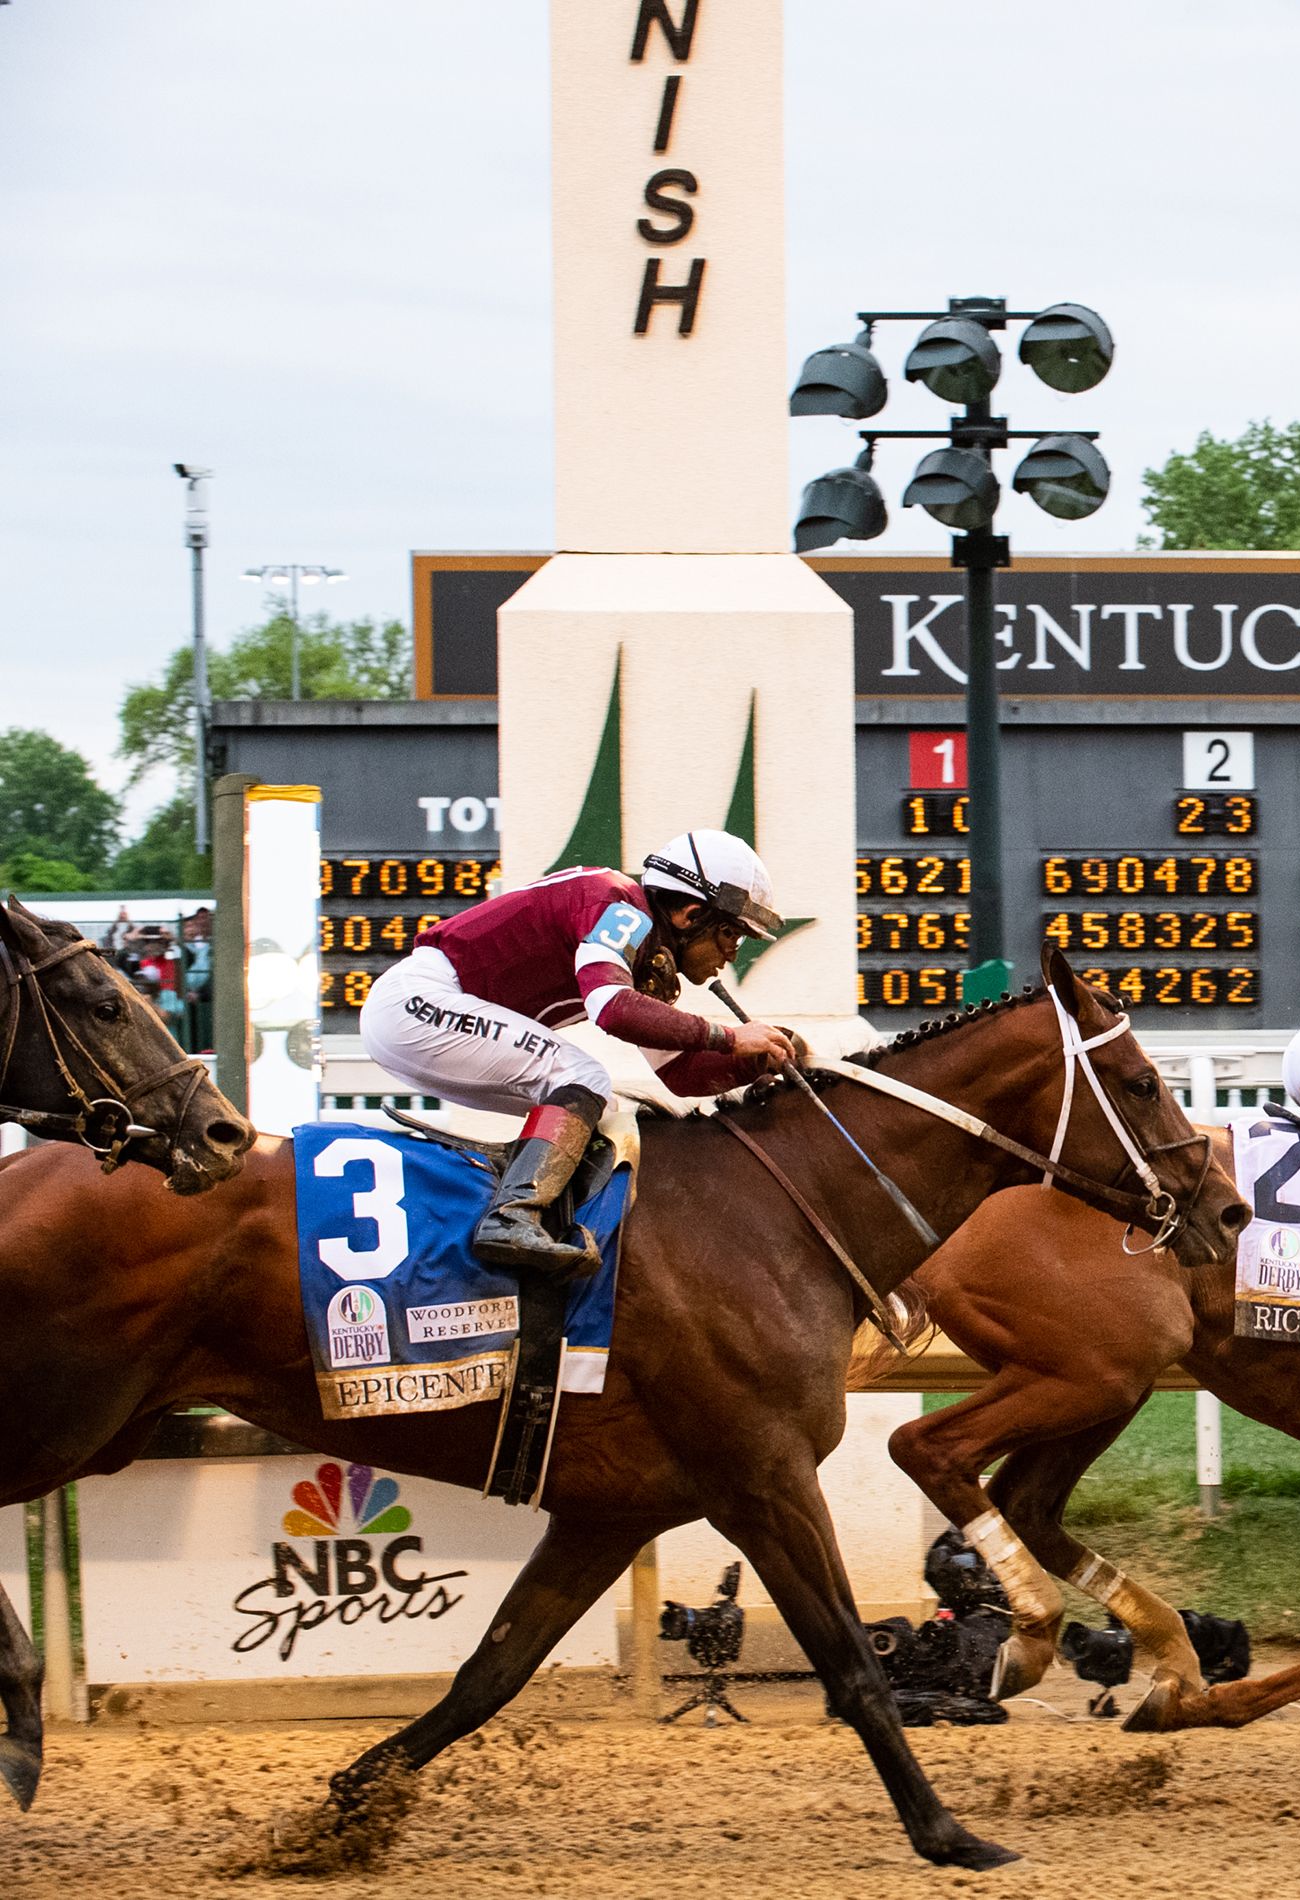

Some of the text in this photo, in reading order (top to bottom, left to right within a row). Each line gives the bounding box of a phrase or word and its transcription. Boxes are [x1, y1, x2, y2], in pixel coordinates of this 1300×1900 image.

[630, 0, 706, 335] NISH
[933, 738, 956, 784] 1
[1207, 739, 1231, 782] 2
[1045, 857, 1252, 893] 690478
[599, 908, 642, 949] 3
[1046, 912, 1254, 948] 458325
[404, 995, 508, 1041] SENTIENT
[314, 1138, 409, 1282] 3
[332, 1324, 375, 1336] KENTUCKY
[410, 1299, 515, 1322] WOODFORD
[423, 1318, 507, 1339] RESERVE
[333, 1331, 386, 1362] DERBY
[272, 1535, 424, 1598] NBC
[231, 1570, 469, 1661] Sports
